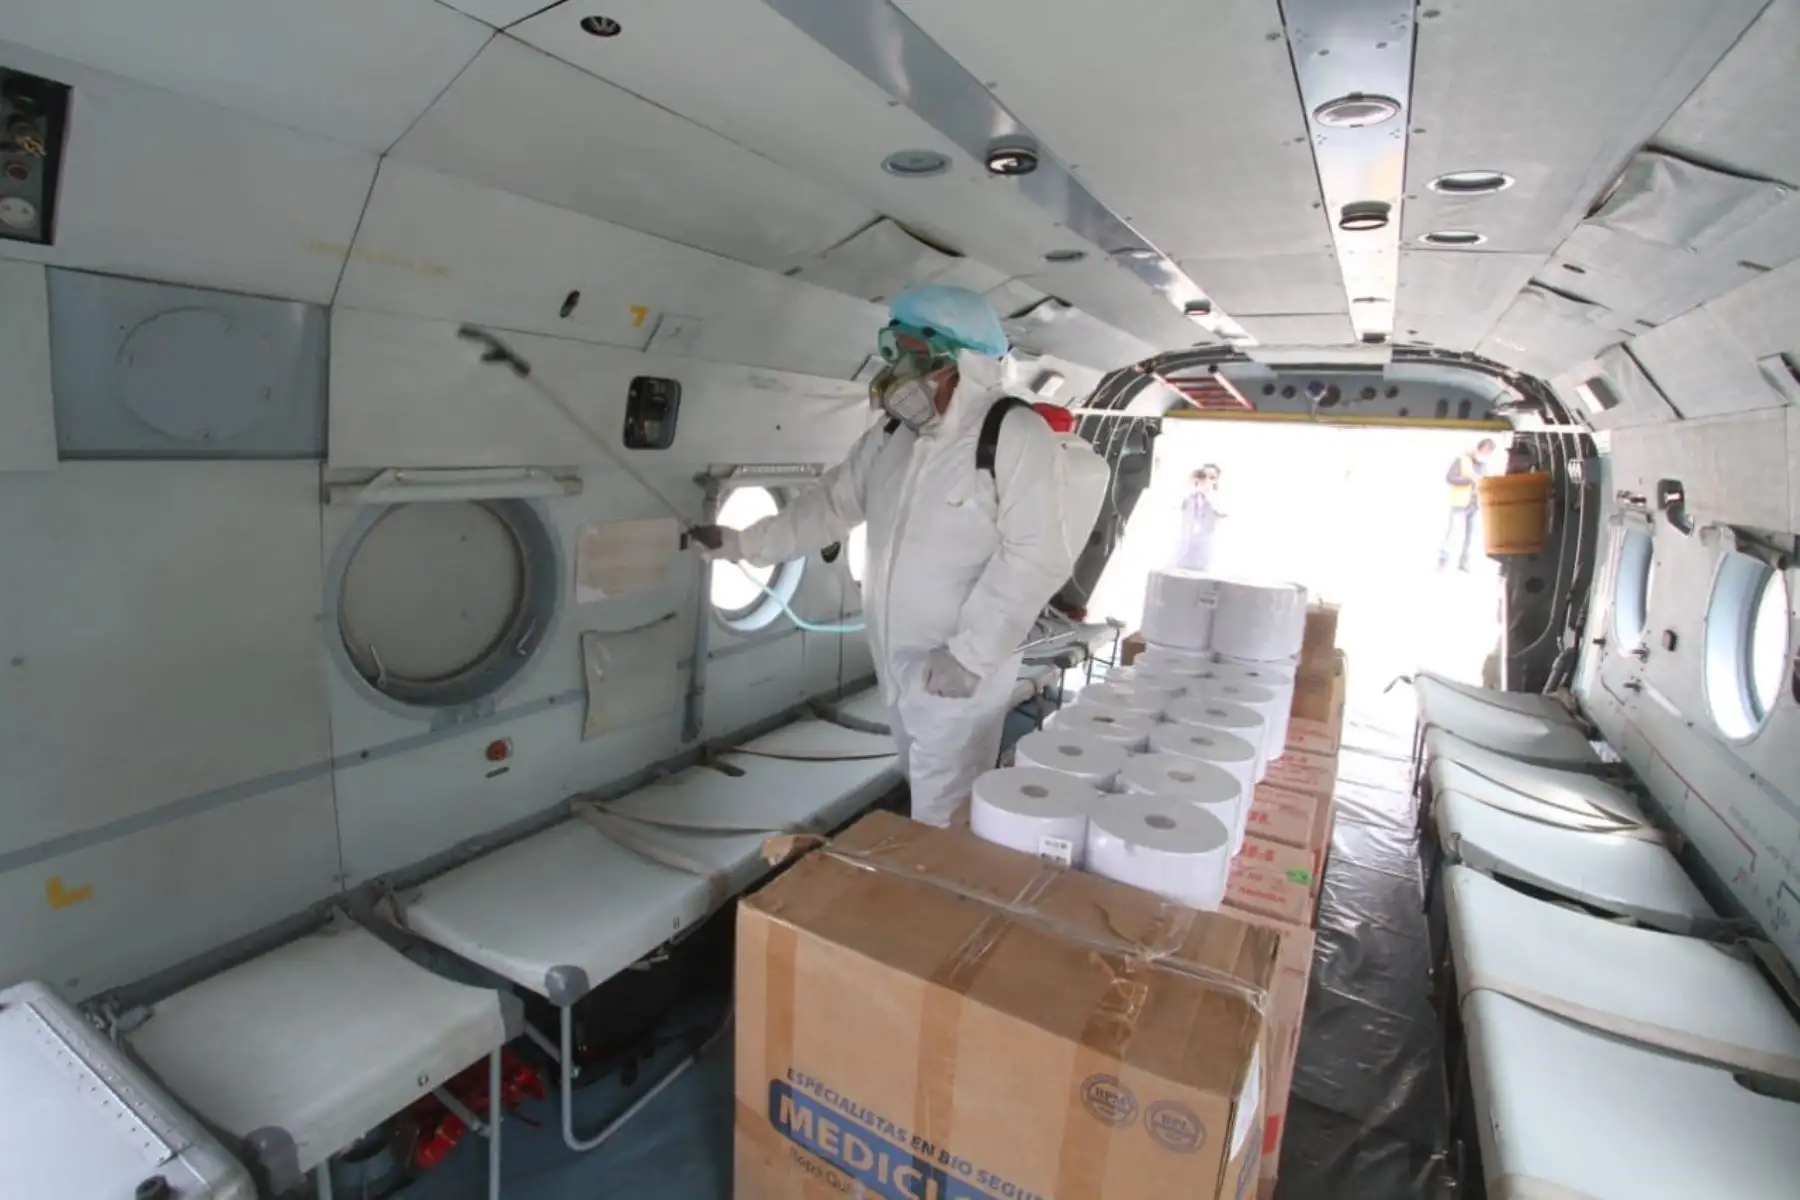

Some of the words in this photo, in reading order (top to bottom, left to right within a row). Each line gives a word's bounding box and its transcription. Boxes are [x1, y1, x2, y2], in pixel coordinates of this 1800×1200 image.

[787, 1067, 908, 1142] ESPECIALISTAS
[910, 1134, 936, 1157] EN
[938, 1147, 973, 1176] BIO
